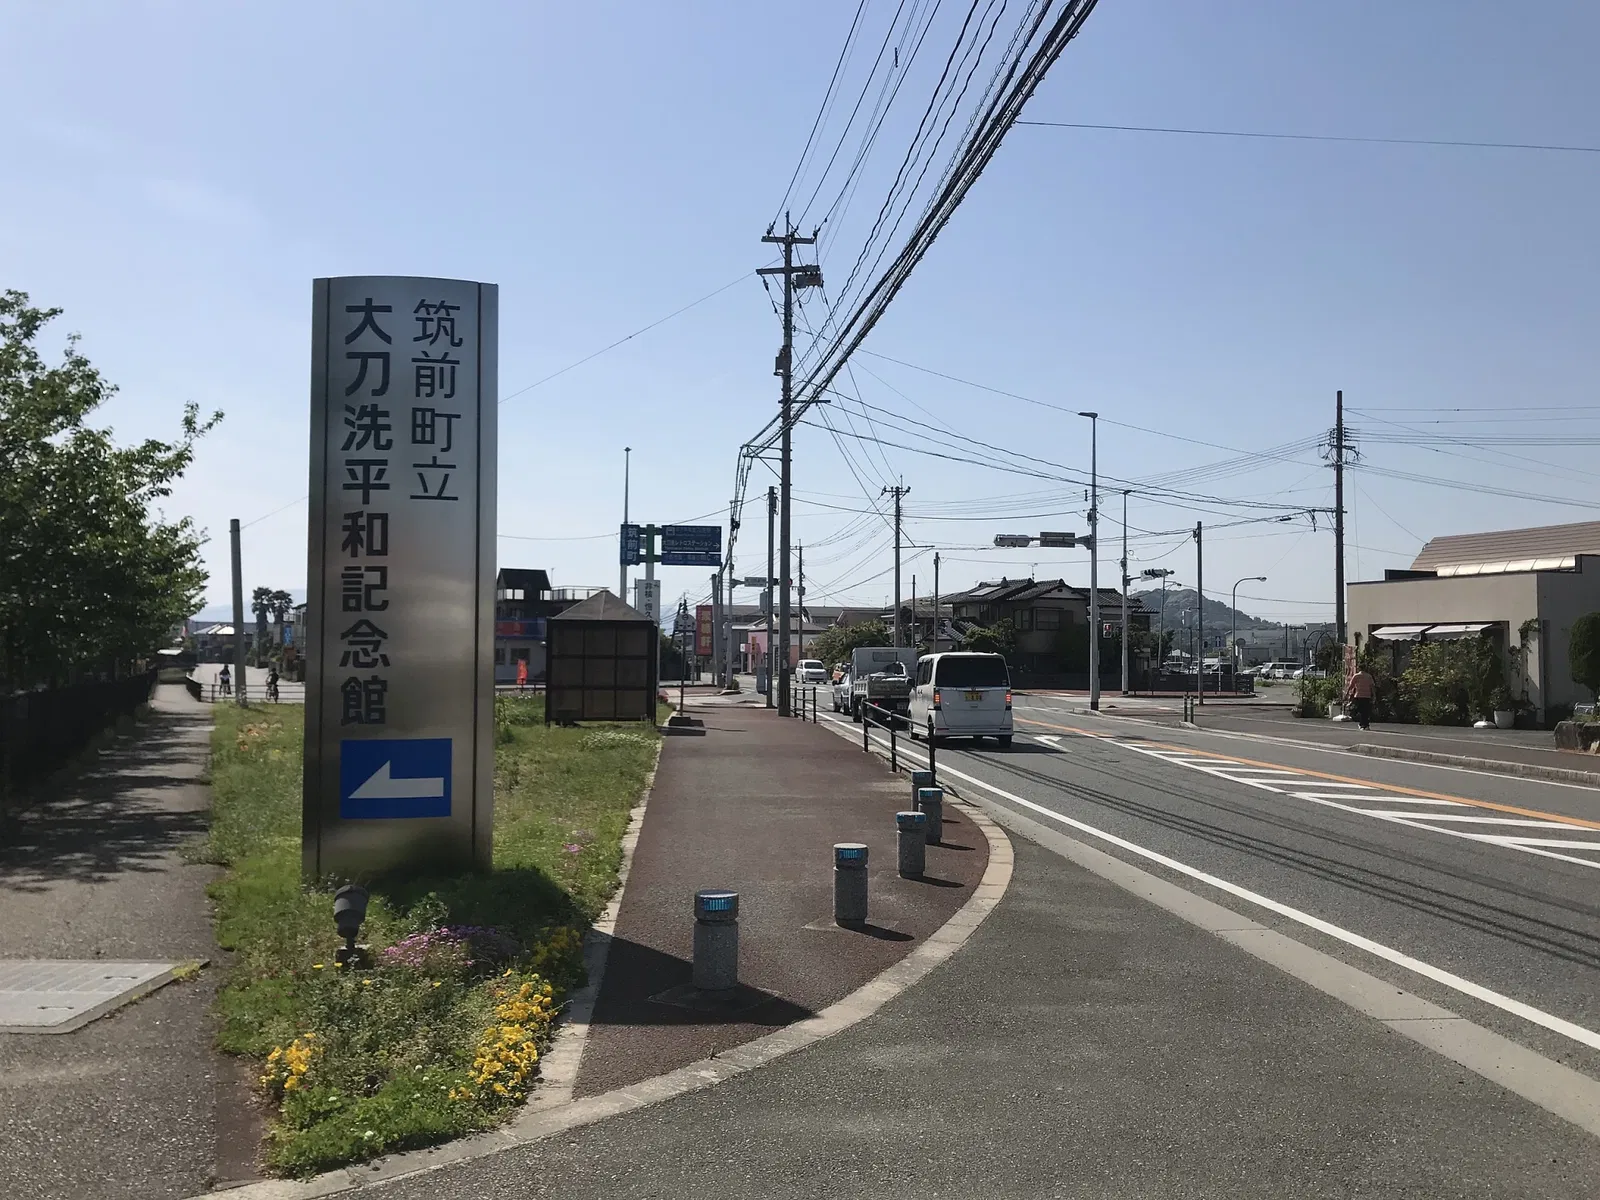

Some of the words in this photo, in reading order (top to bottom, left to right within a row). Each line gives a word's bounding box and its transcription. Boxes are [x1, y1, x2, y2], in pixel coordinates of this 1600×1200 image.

[410, 298, 463, 500] 筑前町立
[339, 297, 393, 726] 大刀洗平和記念館
[627, 527, 638, 561] 筑前町
